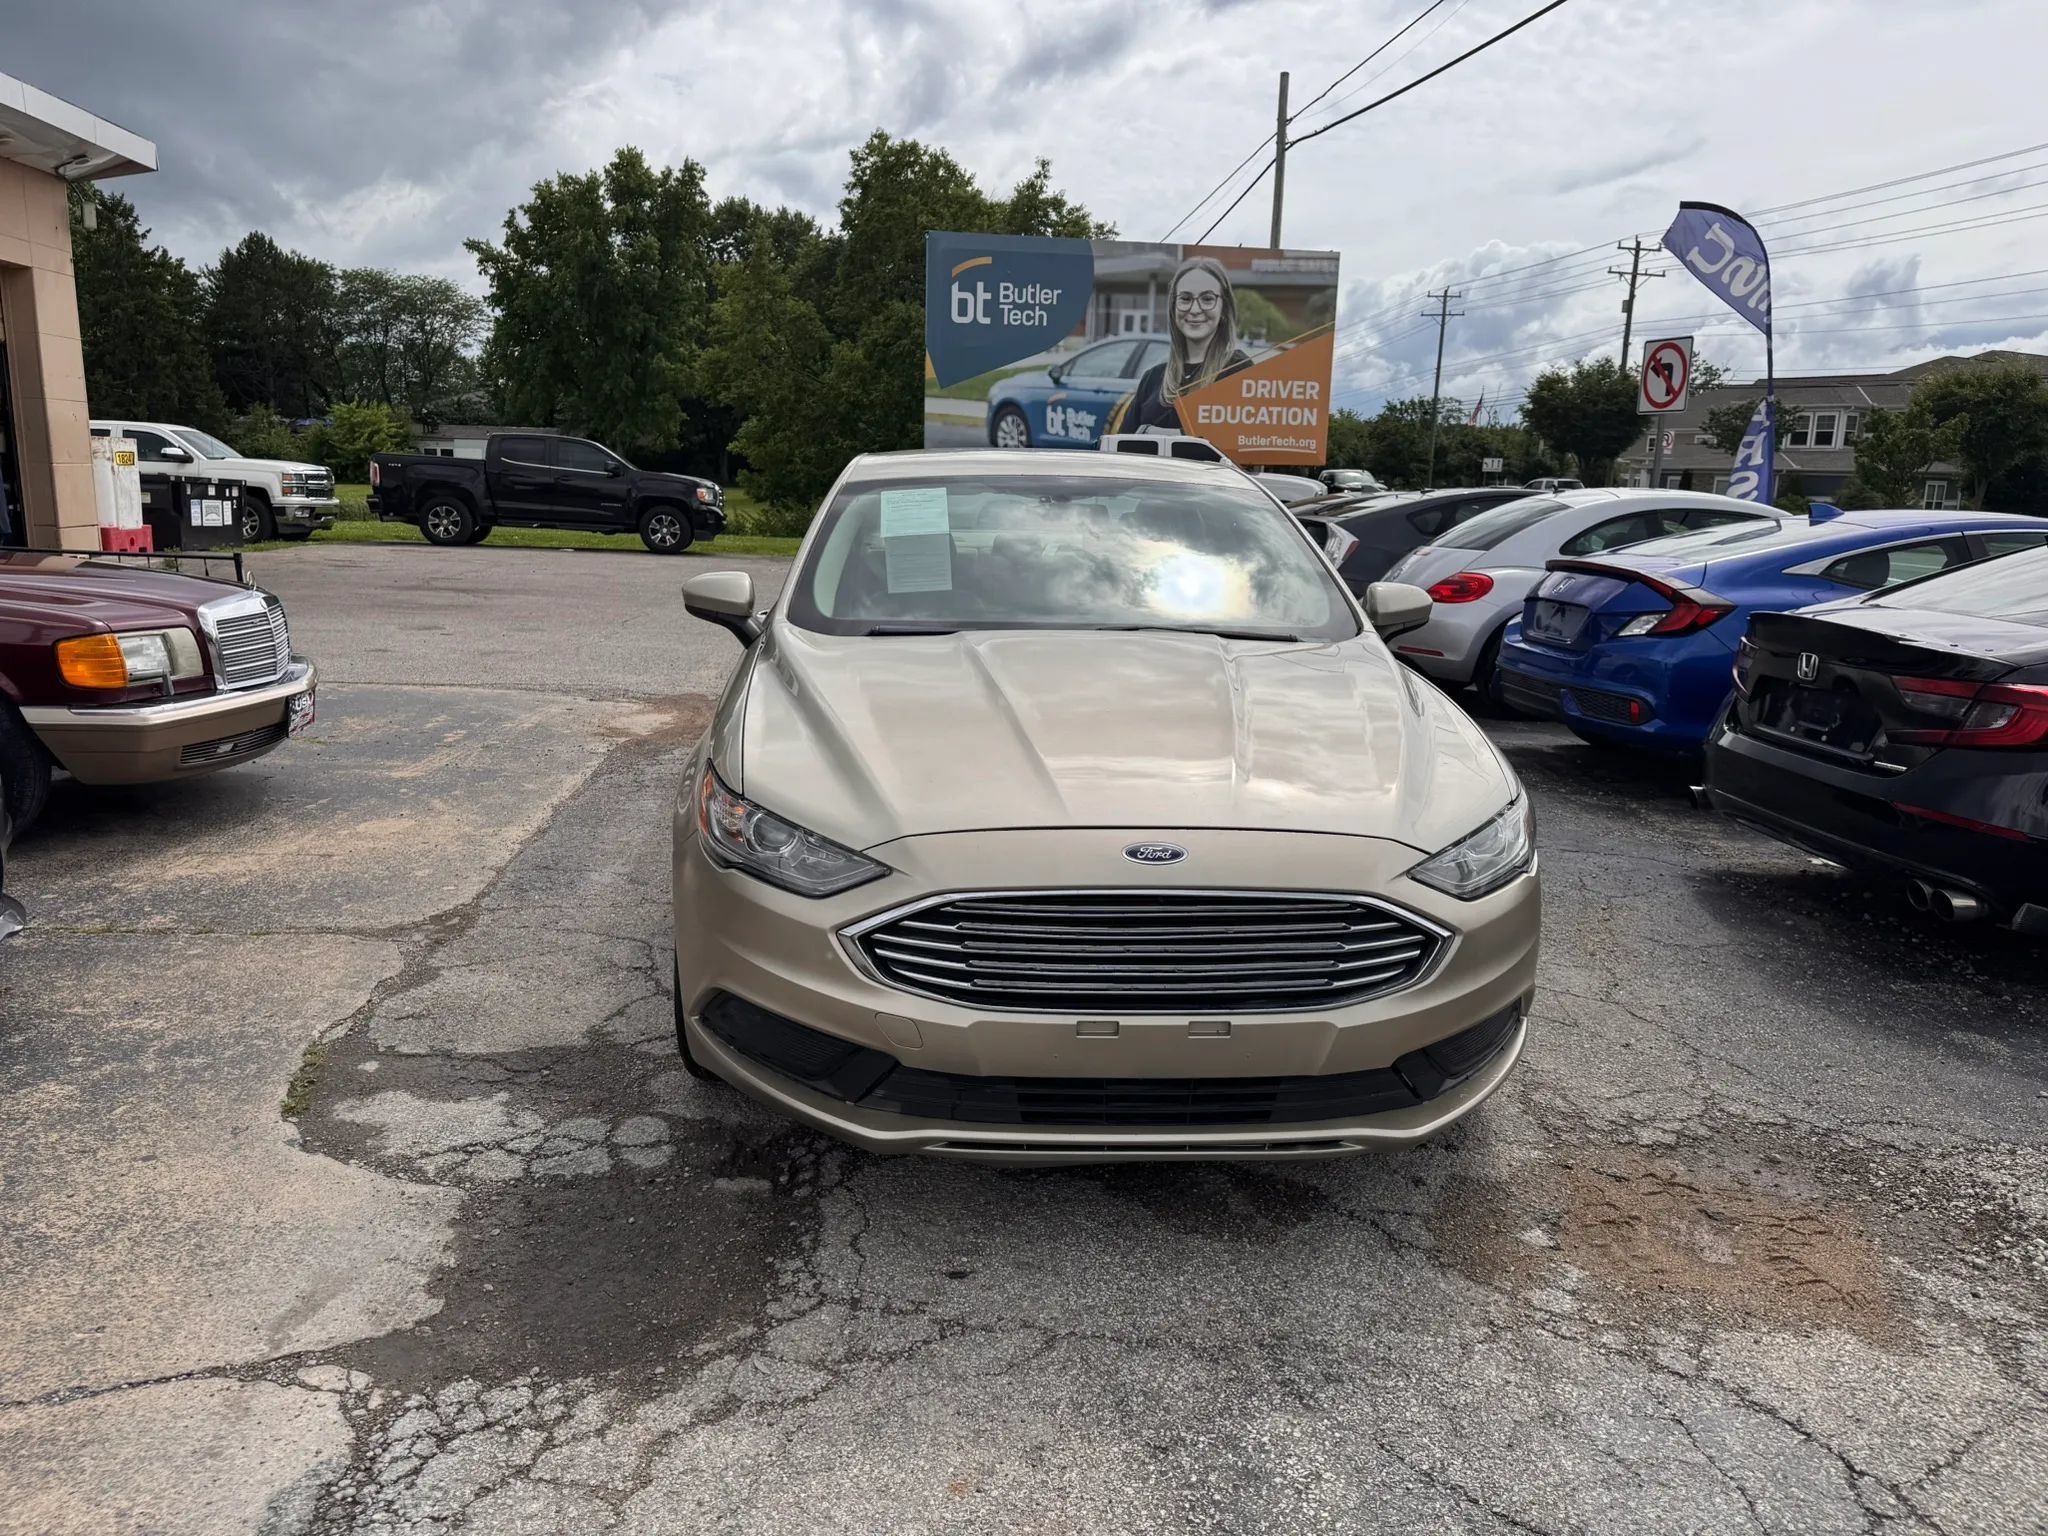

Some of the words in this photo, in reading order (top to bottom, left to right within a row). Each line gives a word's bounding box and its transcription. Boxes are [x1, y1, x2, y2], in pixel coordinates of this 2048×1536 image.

[951, 281, 992, 325] bt
[999, 282, 1062, 305] Butler
[999, 304, 1048, 326] Tech
[1241, 379, 1320, 400] DRIVER
[1197, 404, 1318, 426] EDUCATION
[1238, 435, 1317, 449] ButlerTech.org
[1137, 846, 1173, 859] Ford
